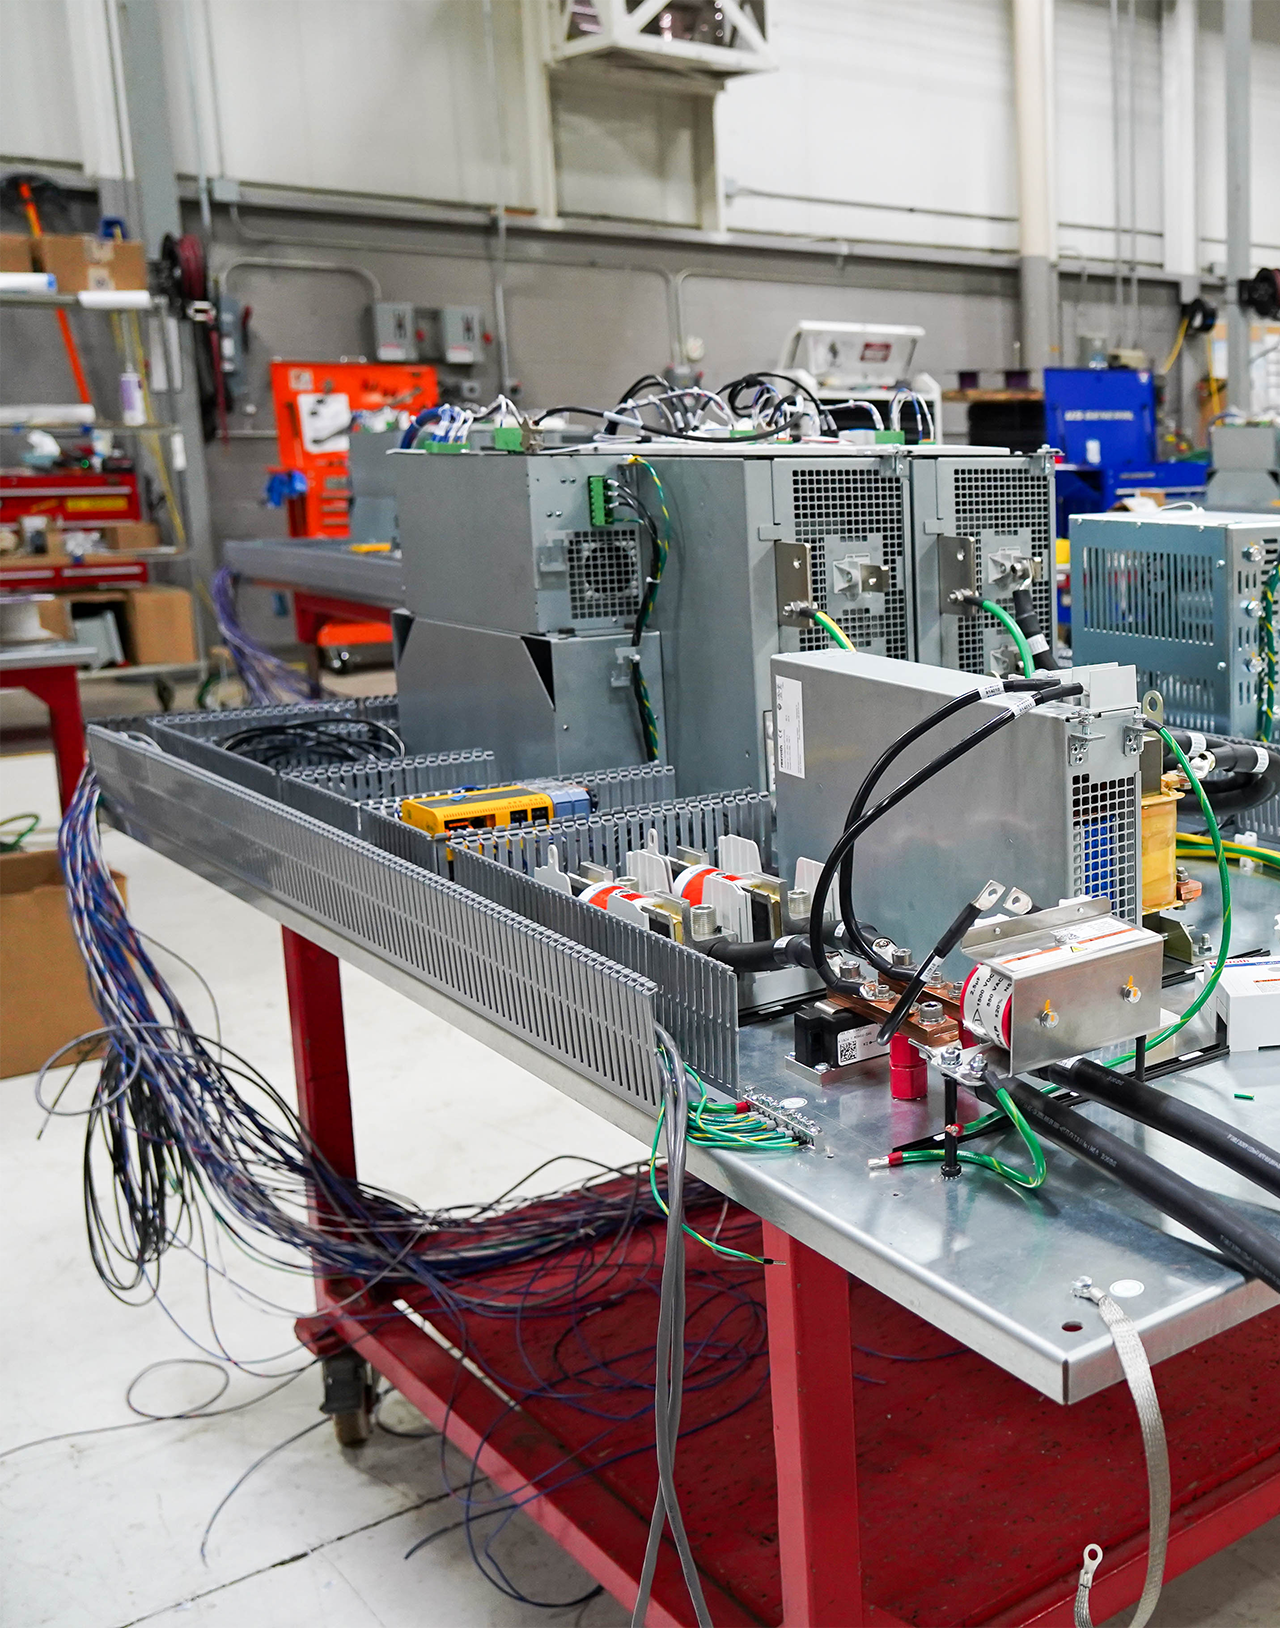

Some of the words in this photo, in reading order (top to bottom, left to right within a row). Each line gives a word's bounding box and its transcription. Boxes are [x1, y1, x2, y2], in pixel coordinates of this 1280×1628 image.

[977, 989, 985, 1006] 1500
[983, 973, 995, 987] VDC
[986, 993, 994, 1008] 550
[992, 977, 1004, 992] VAC
